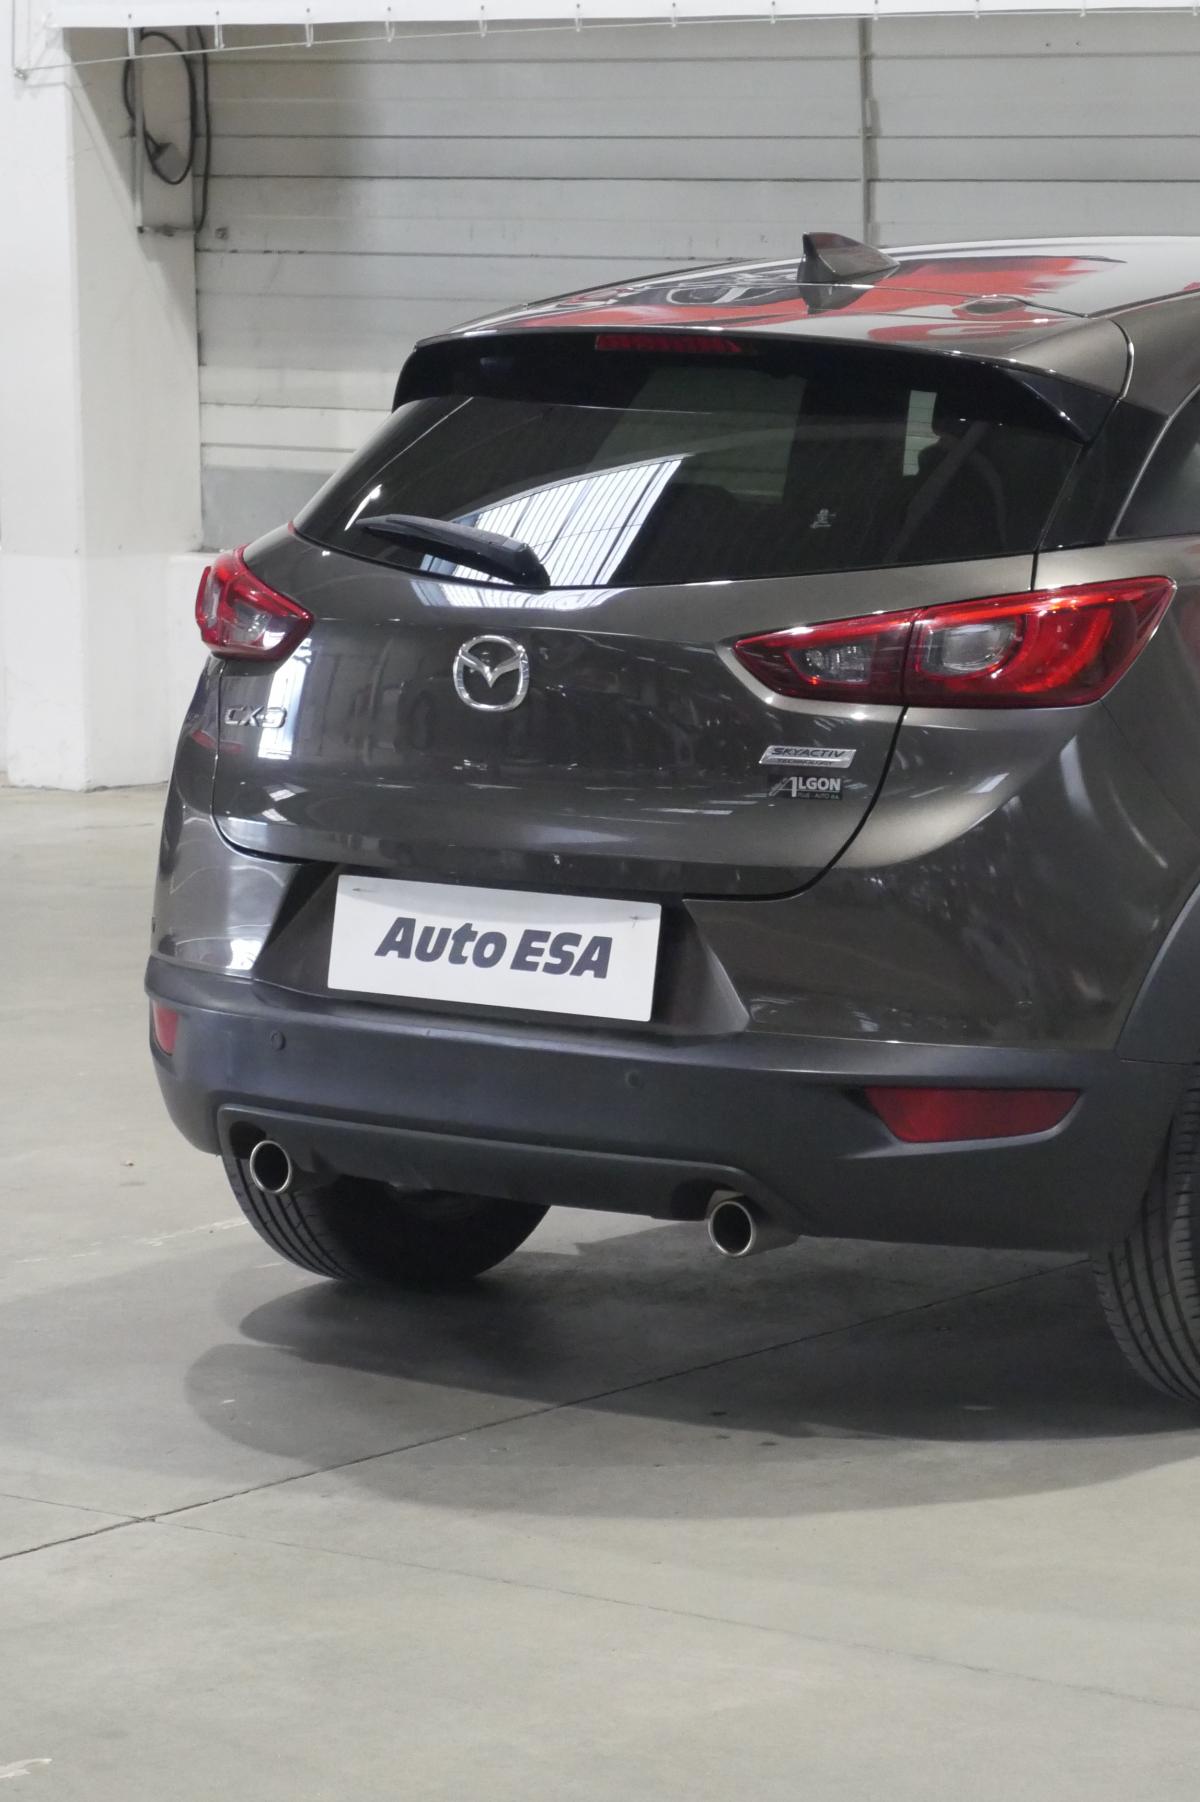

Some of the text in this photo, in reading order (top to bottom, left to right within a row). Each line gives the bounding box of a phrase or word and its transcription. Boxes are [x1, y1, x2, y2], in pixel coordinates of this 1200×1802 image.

[224, 705, 288, 728] CX-3
[771, 747, 845, 758] SKYACTIV
[768, 776, 841, 797] ALGON
[374, 916, 614, 980] Auto ESA
